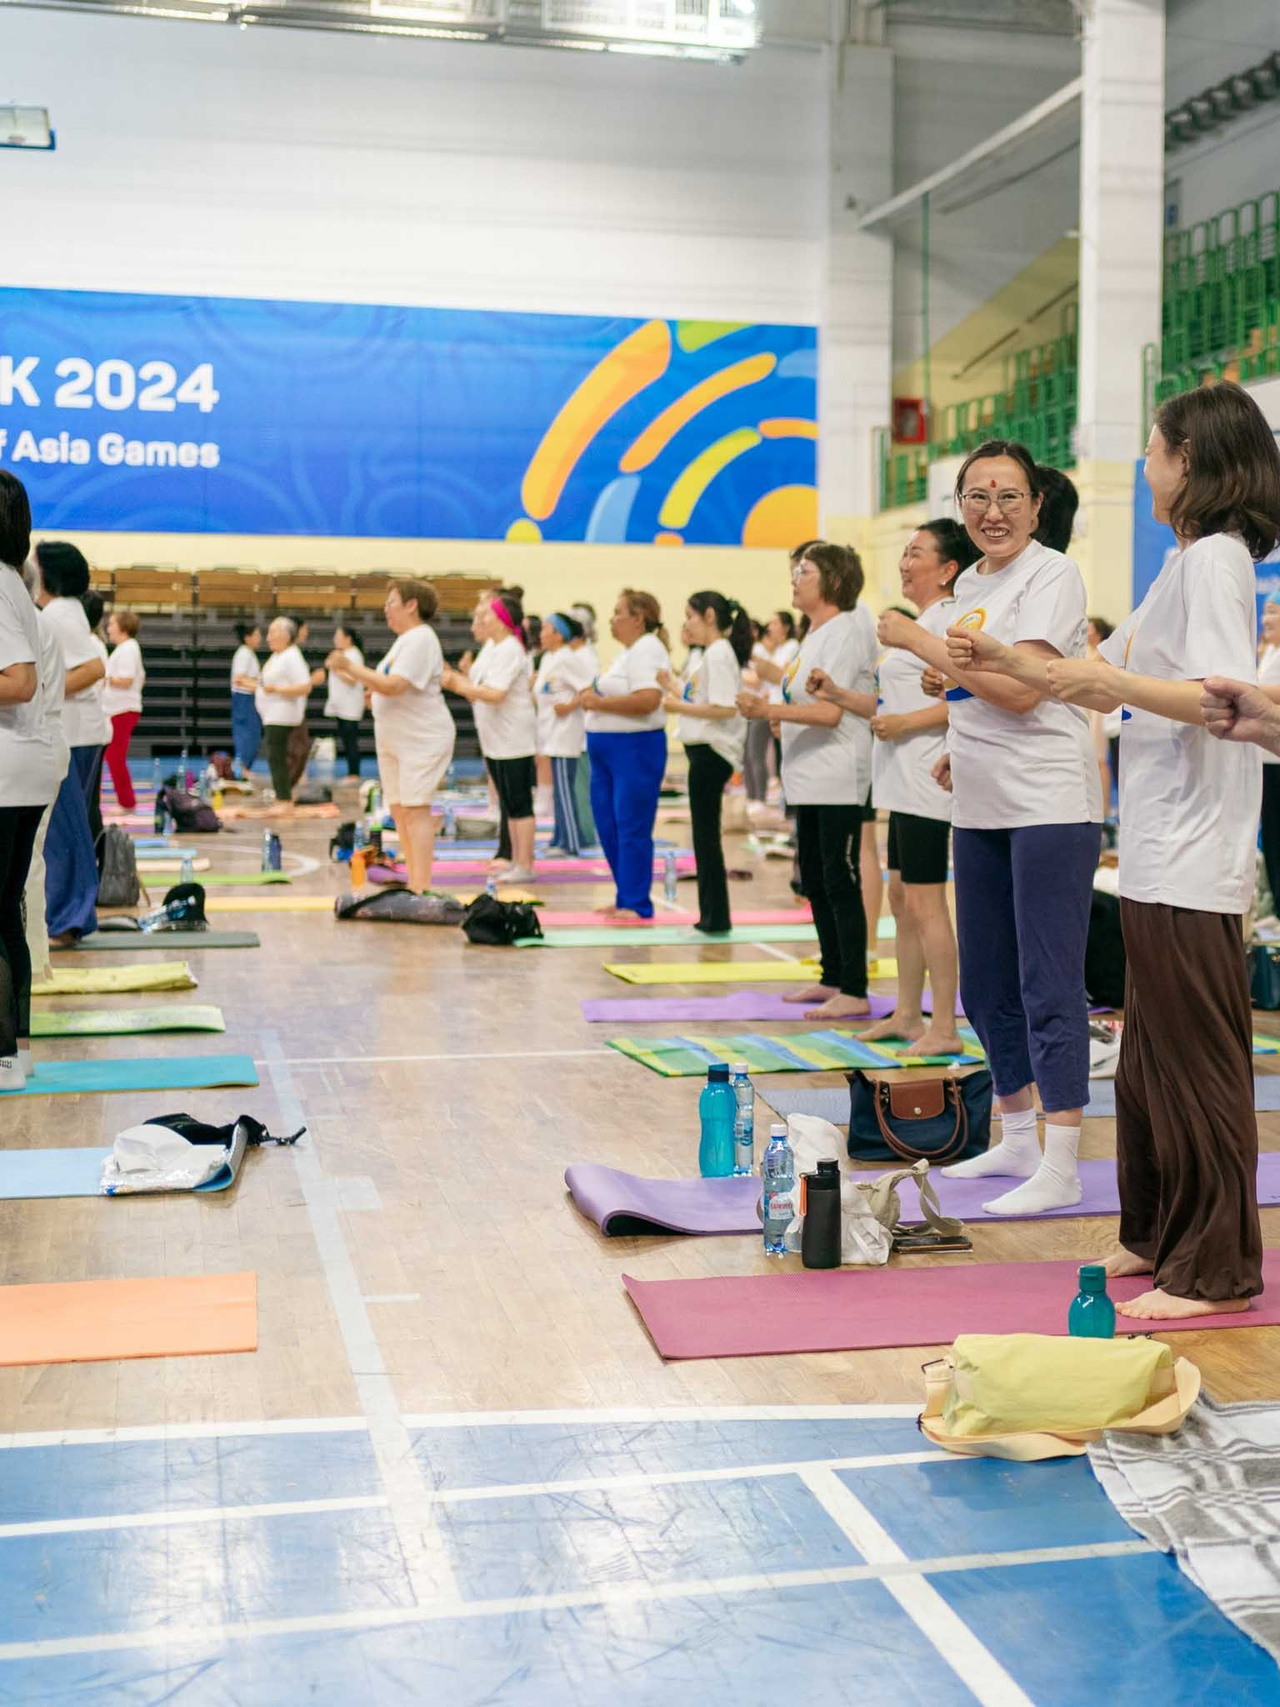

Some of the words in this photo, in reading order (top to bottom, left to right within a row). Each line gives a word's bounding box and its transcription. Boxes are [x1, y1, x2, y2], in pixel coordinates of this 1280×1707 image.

[54, 357, 220, 413] 2024
[11, 430, 91, 465] Asia
[97, 432, 220, 468] Games
